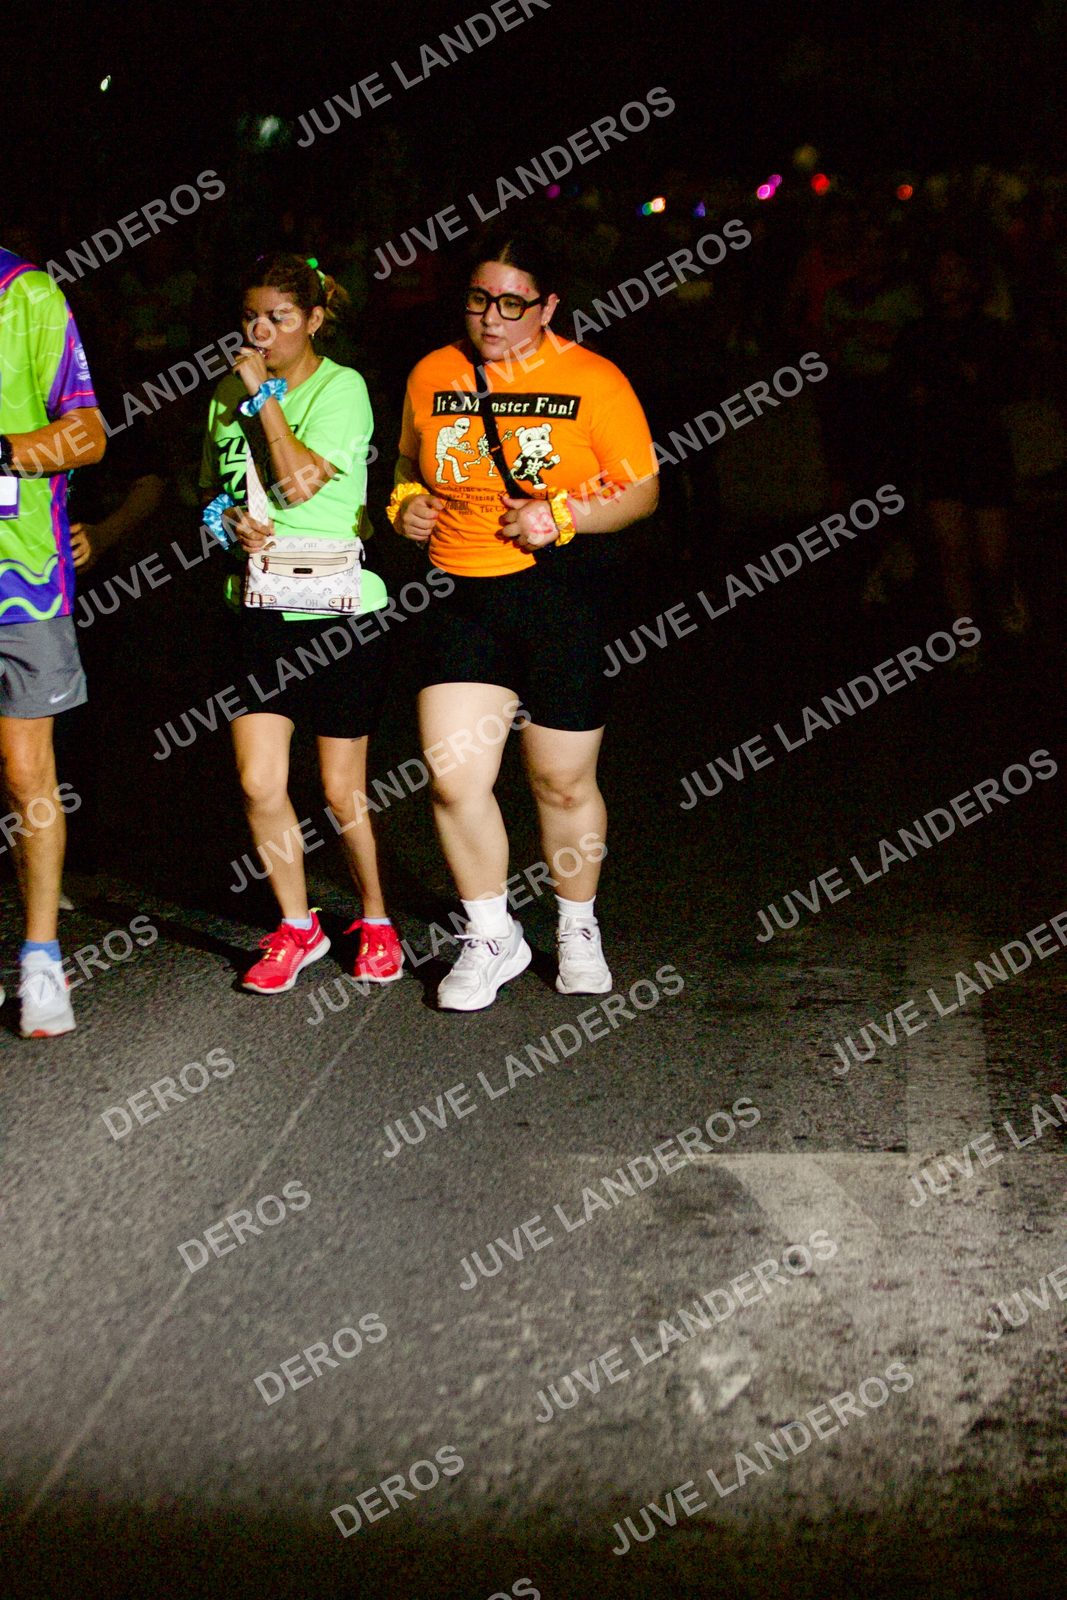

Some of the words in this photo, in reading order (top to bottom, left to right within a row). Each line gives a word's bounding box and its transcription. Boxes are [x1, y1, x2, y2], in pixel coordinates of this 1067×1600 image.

[436, 396, 458, 412] It's
[462, 396, 530, 413] Mnster
[535, 397, 576, 415] Fun!
